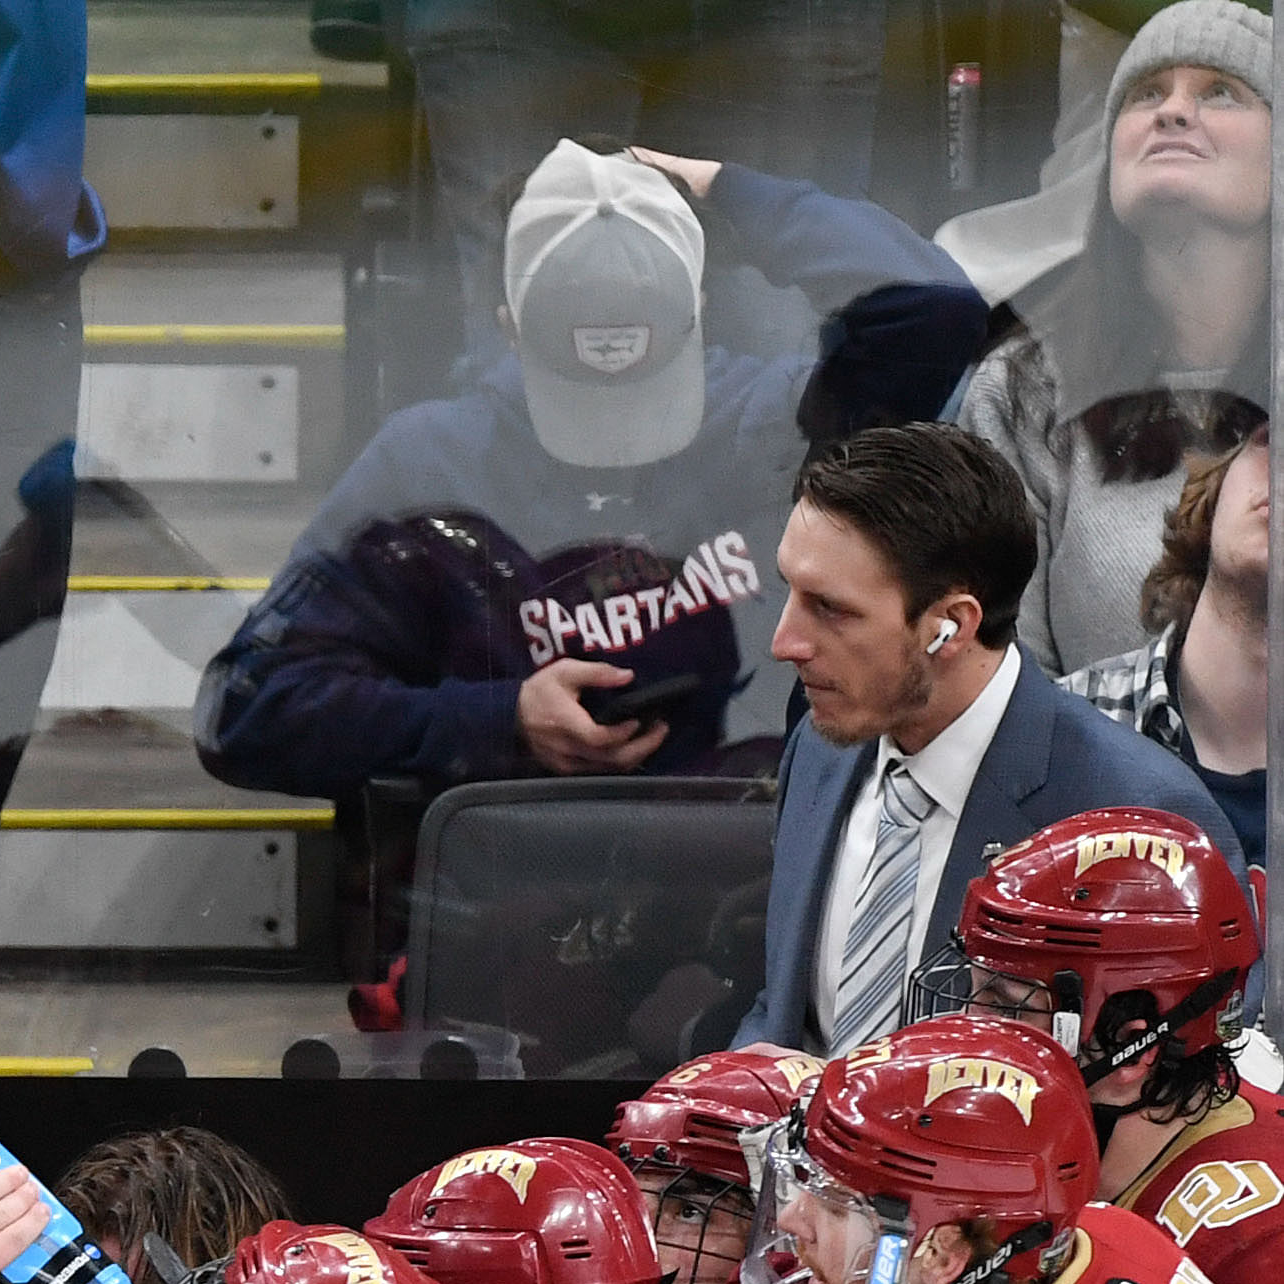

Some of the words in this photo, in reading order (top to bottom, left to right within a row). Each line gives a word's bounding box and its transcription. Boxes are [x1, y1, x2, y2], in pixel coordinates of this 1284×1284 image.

[519, 530, 760, 667] SPARTANS
[1074, 831, 1187, 890] DENVER
[1111, 1021, 1169, 1066] BAUER
[923, 1058, 1040, 1127] DENVER
